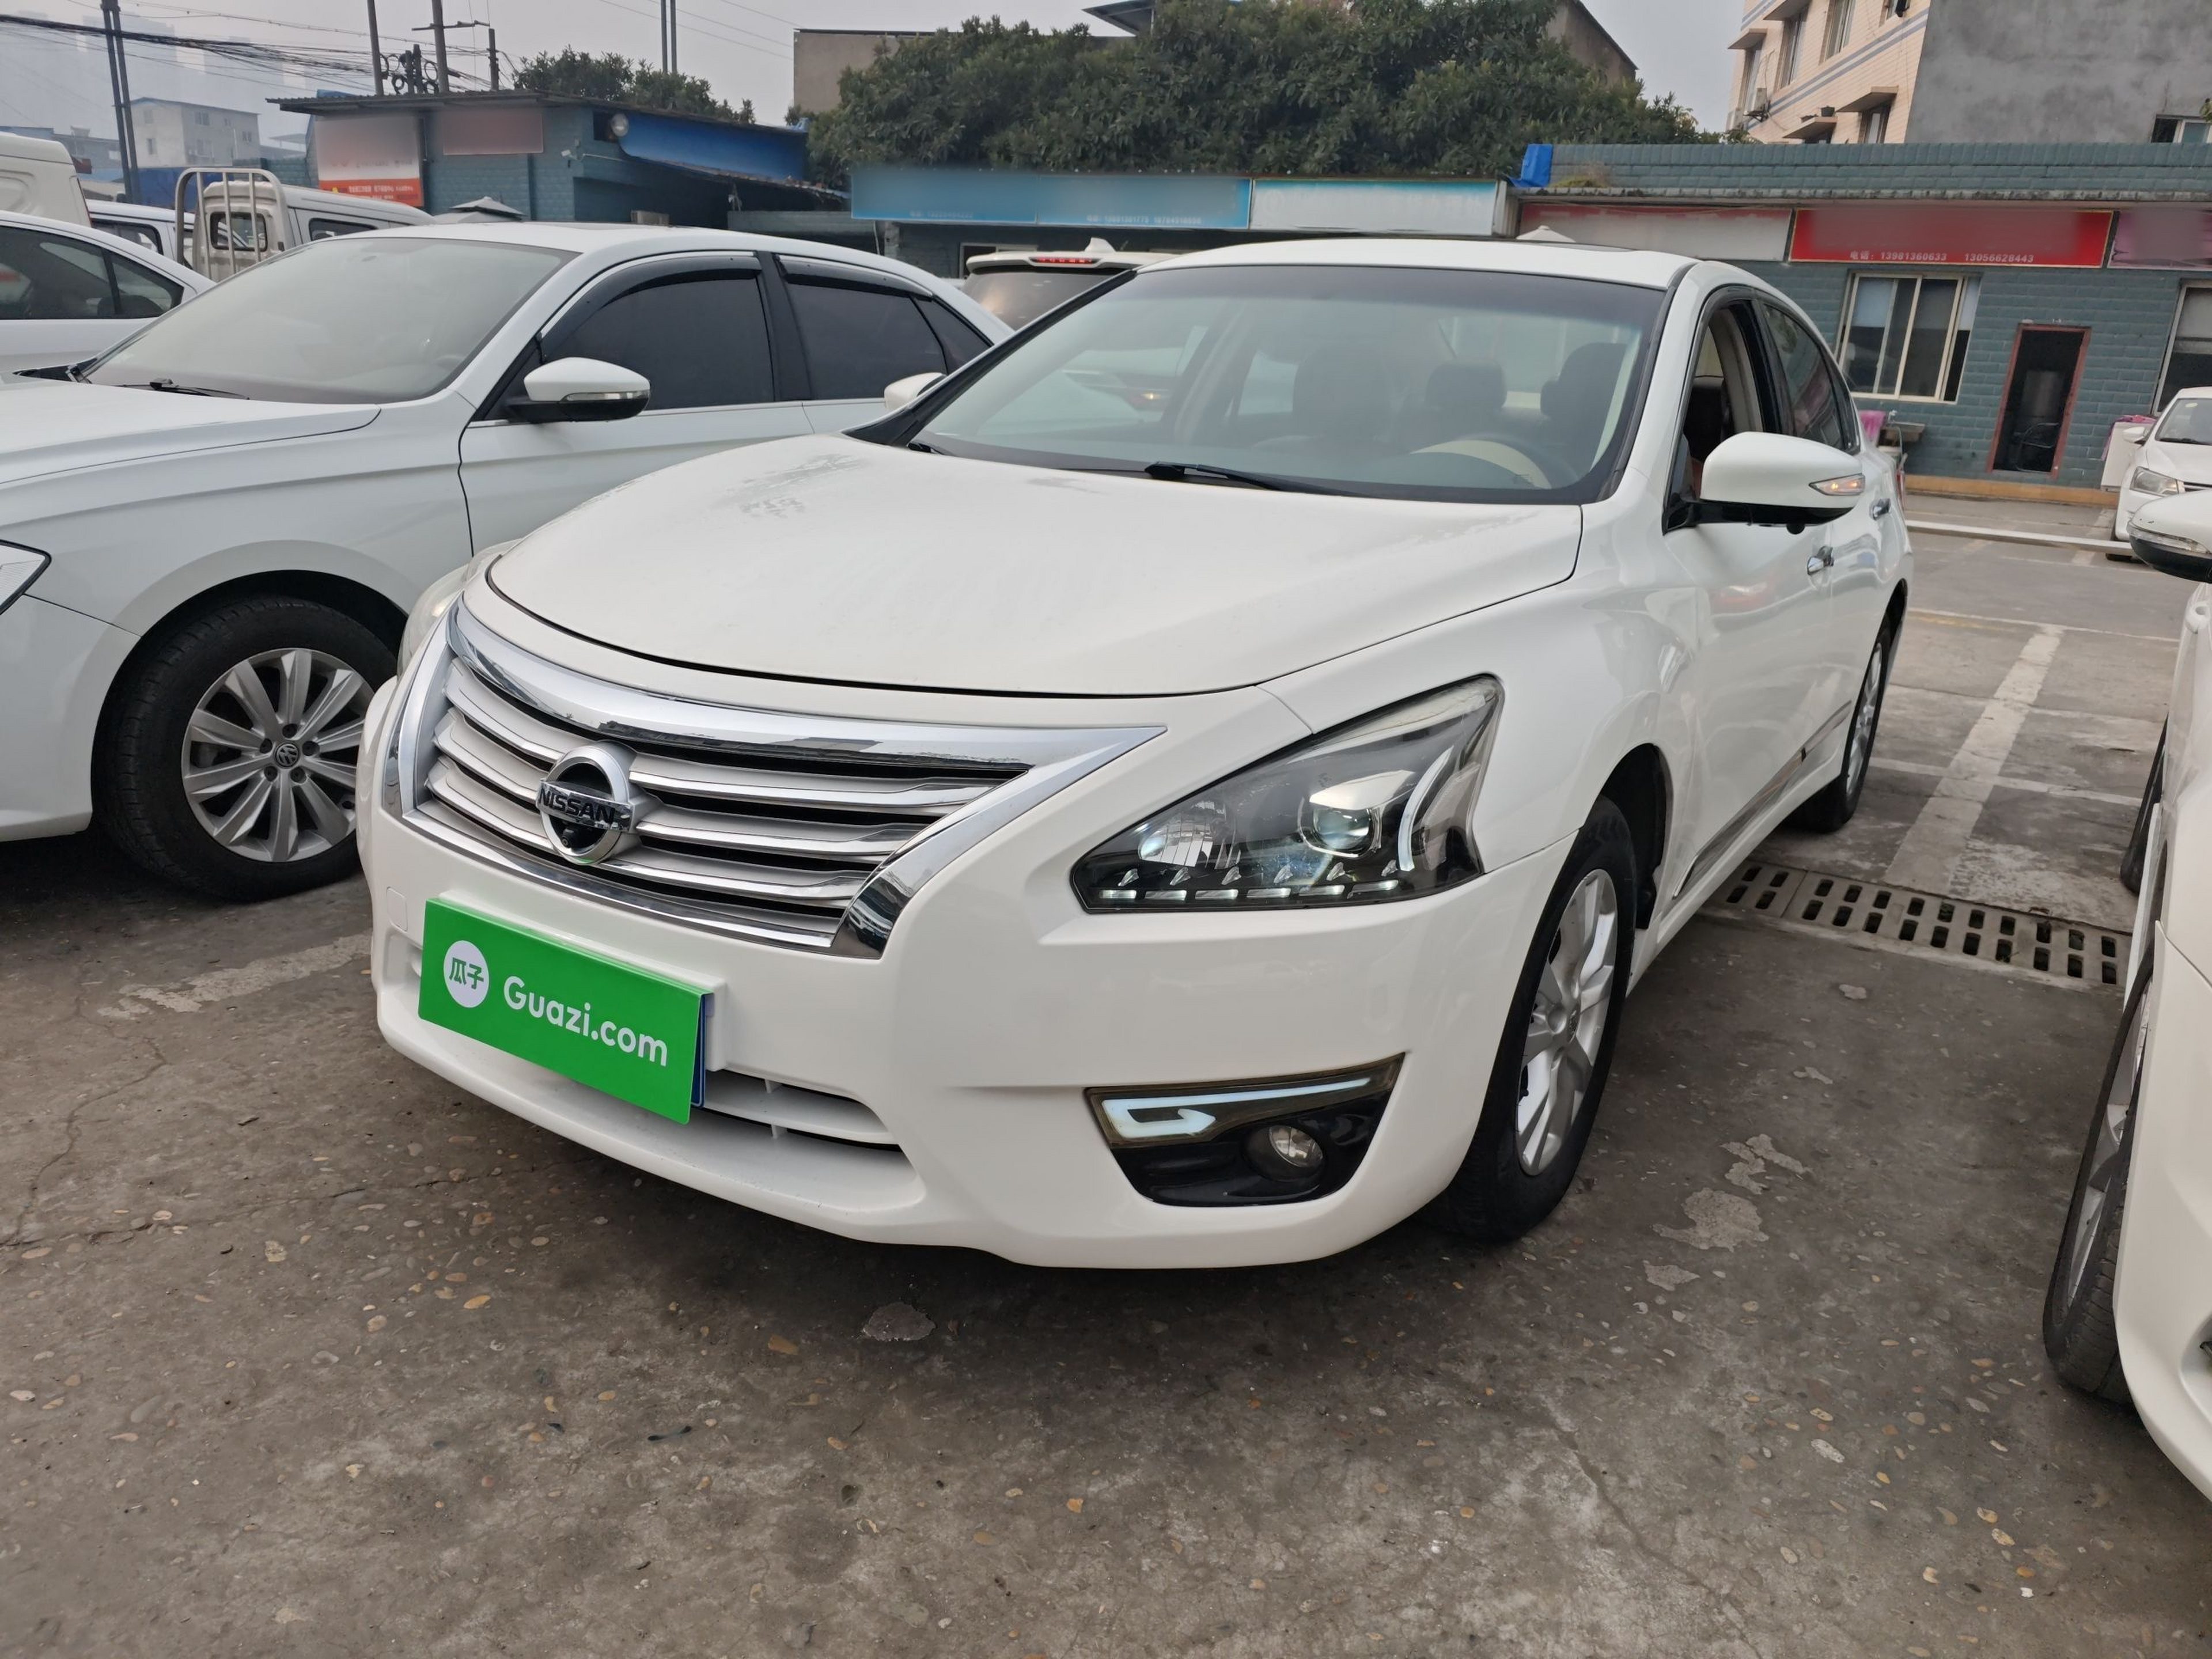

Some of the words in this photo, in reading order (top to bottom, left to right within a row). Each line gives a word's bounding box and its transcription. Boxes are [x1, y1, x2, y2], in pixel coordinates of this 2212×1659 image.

[539, 786, 616, 824] NISSAN
[448, 956, 484, 991] 瓜子
[503, 975, 668, 1067] Guazi.com
